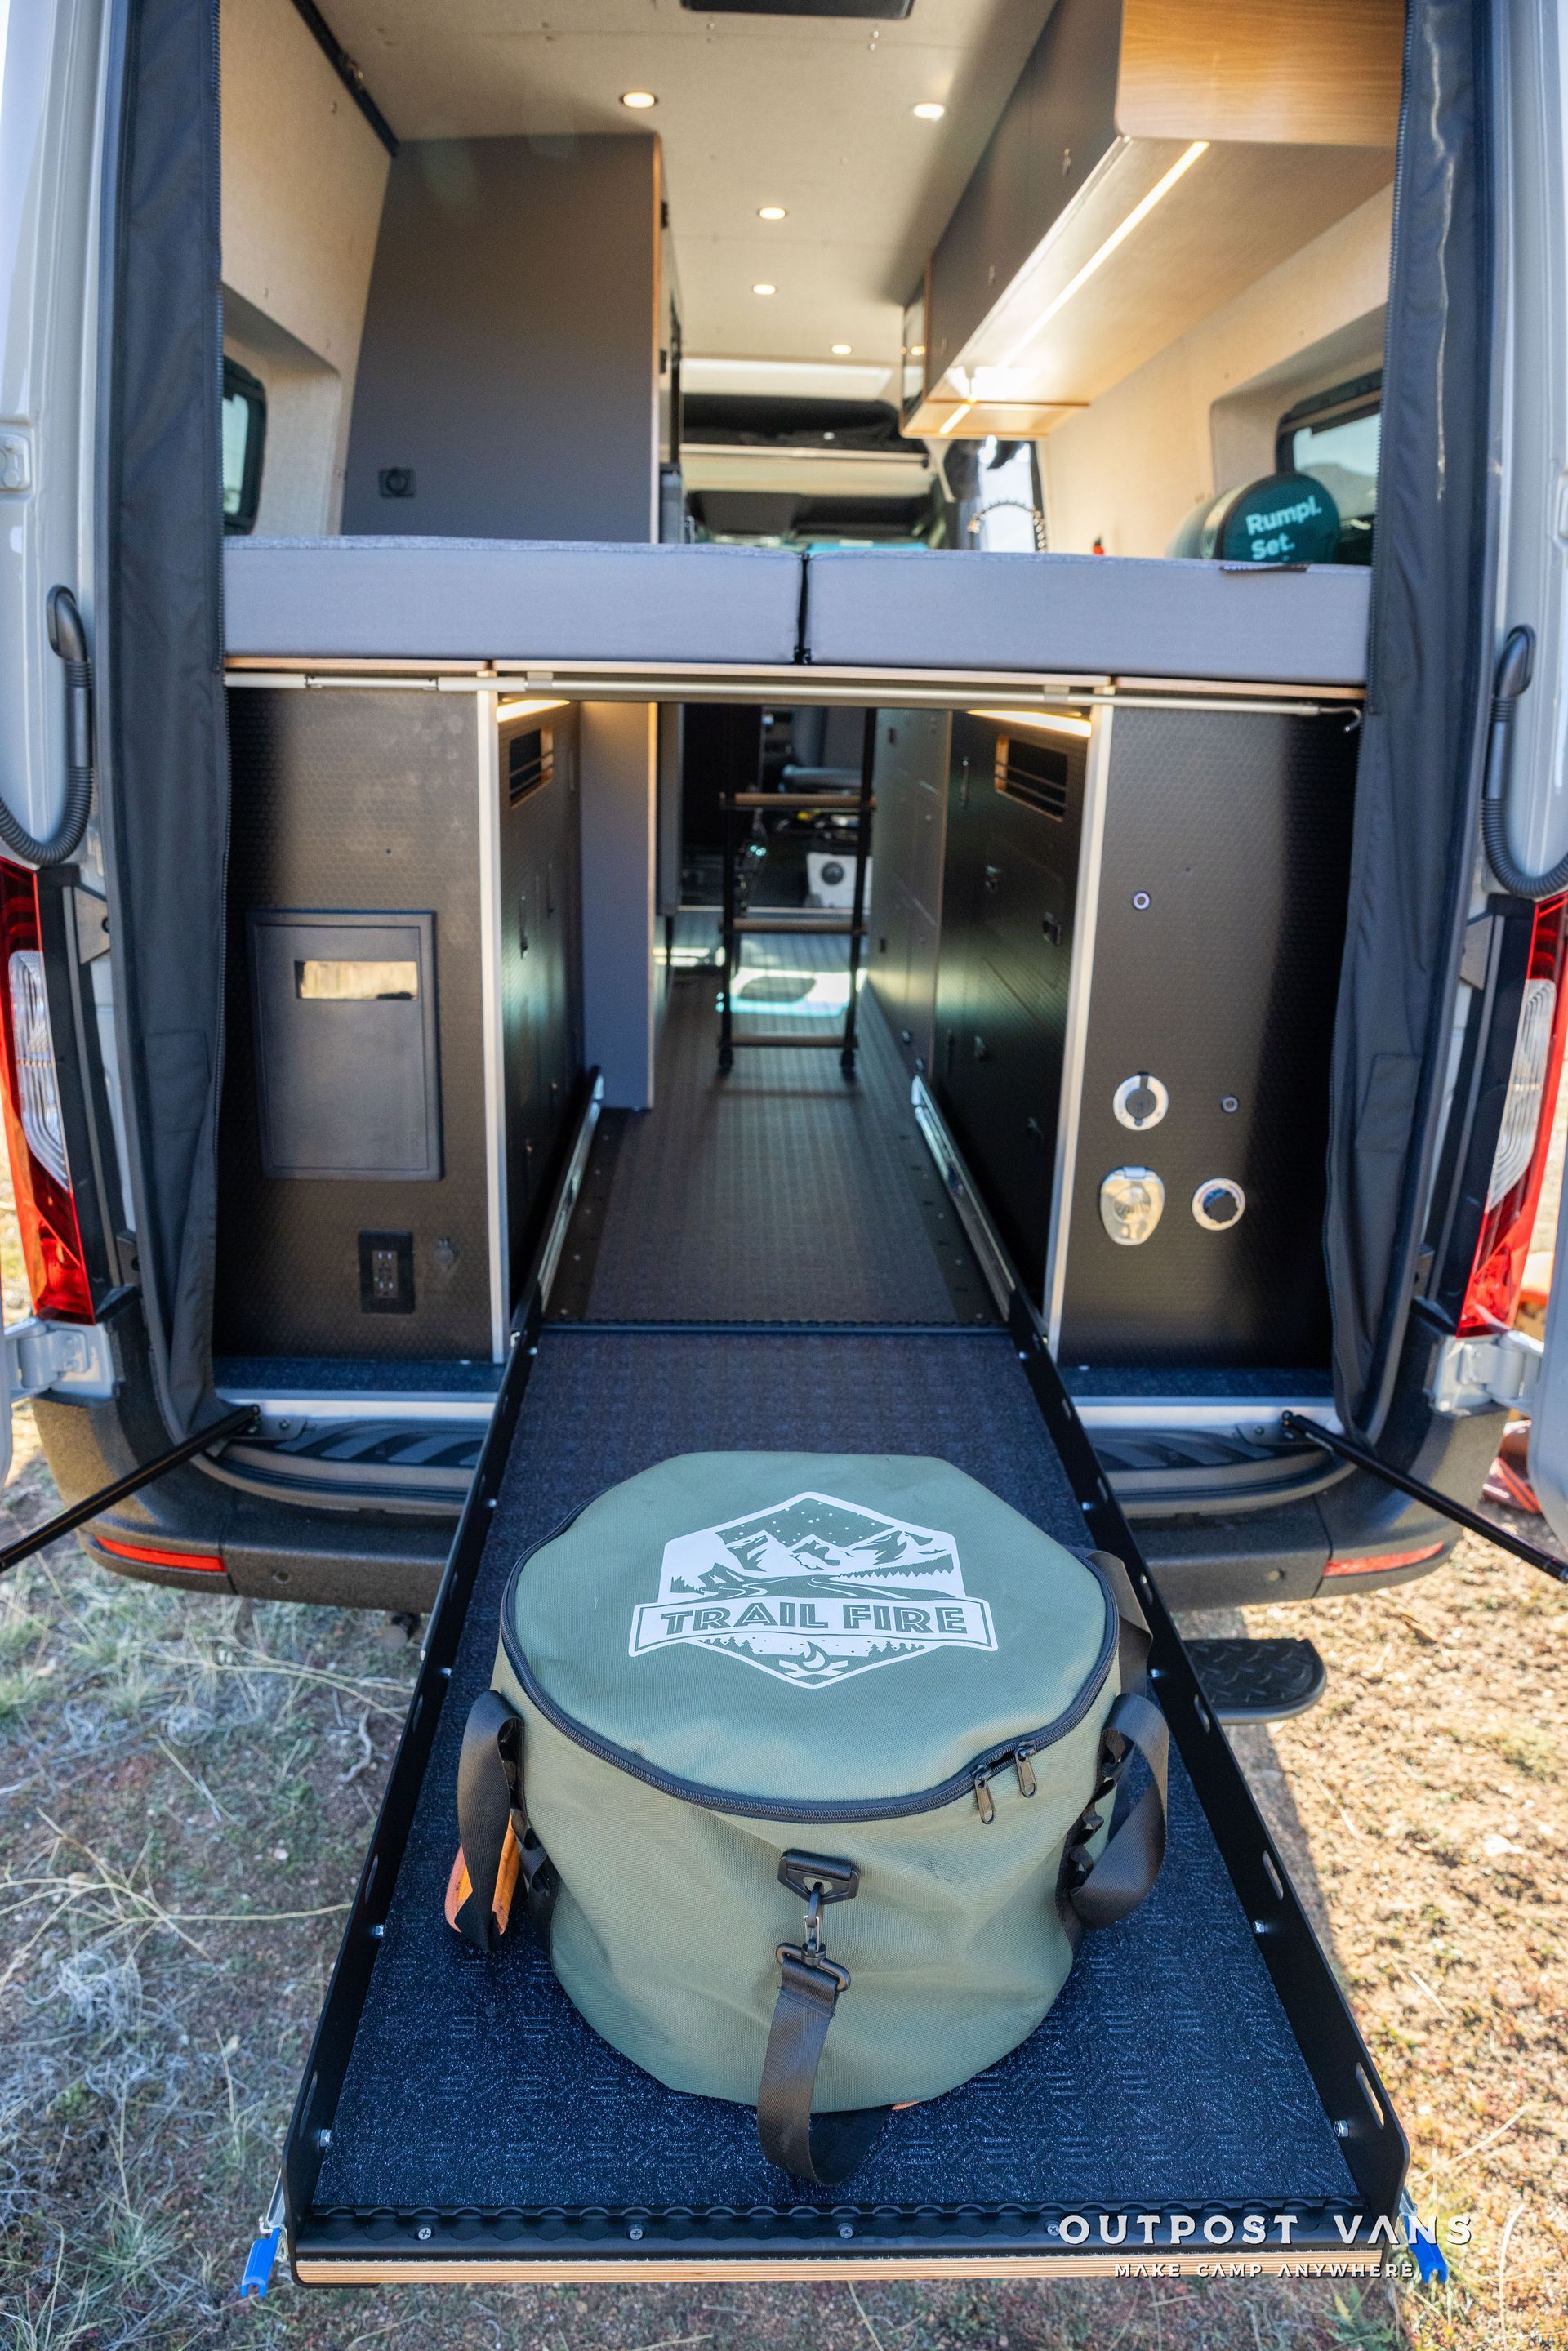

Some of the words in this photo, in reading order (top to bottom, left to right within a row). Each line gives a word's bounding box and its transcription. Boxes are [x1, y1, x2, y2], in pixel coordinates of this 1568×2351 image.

[1245, 495, 1322, 536] Rumpl.
[1251, 533, 1294, 560] Set.
[661, 1602, 829, 1635] TRAIL
[842, 1603, 968, 1634] FIRE
